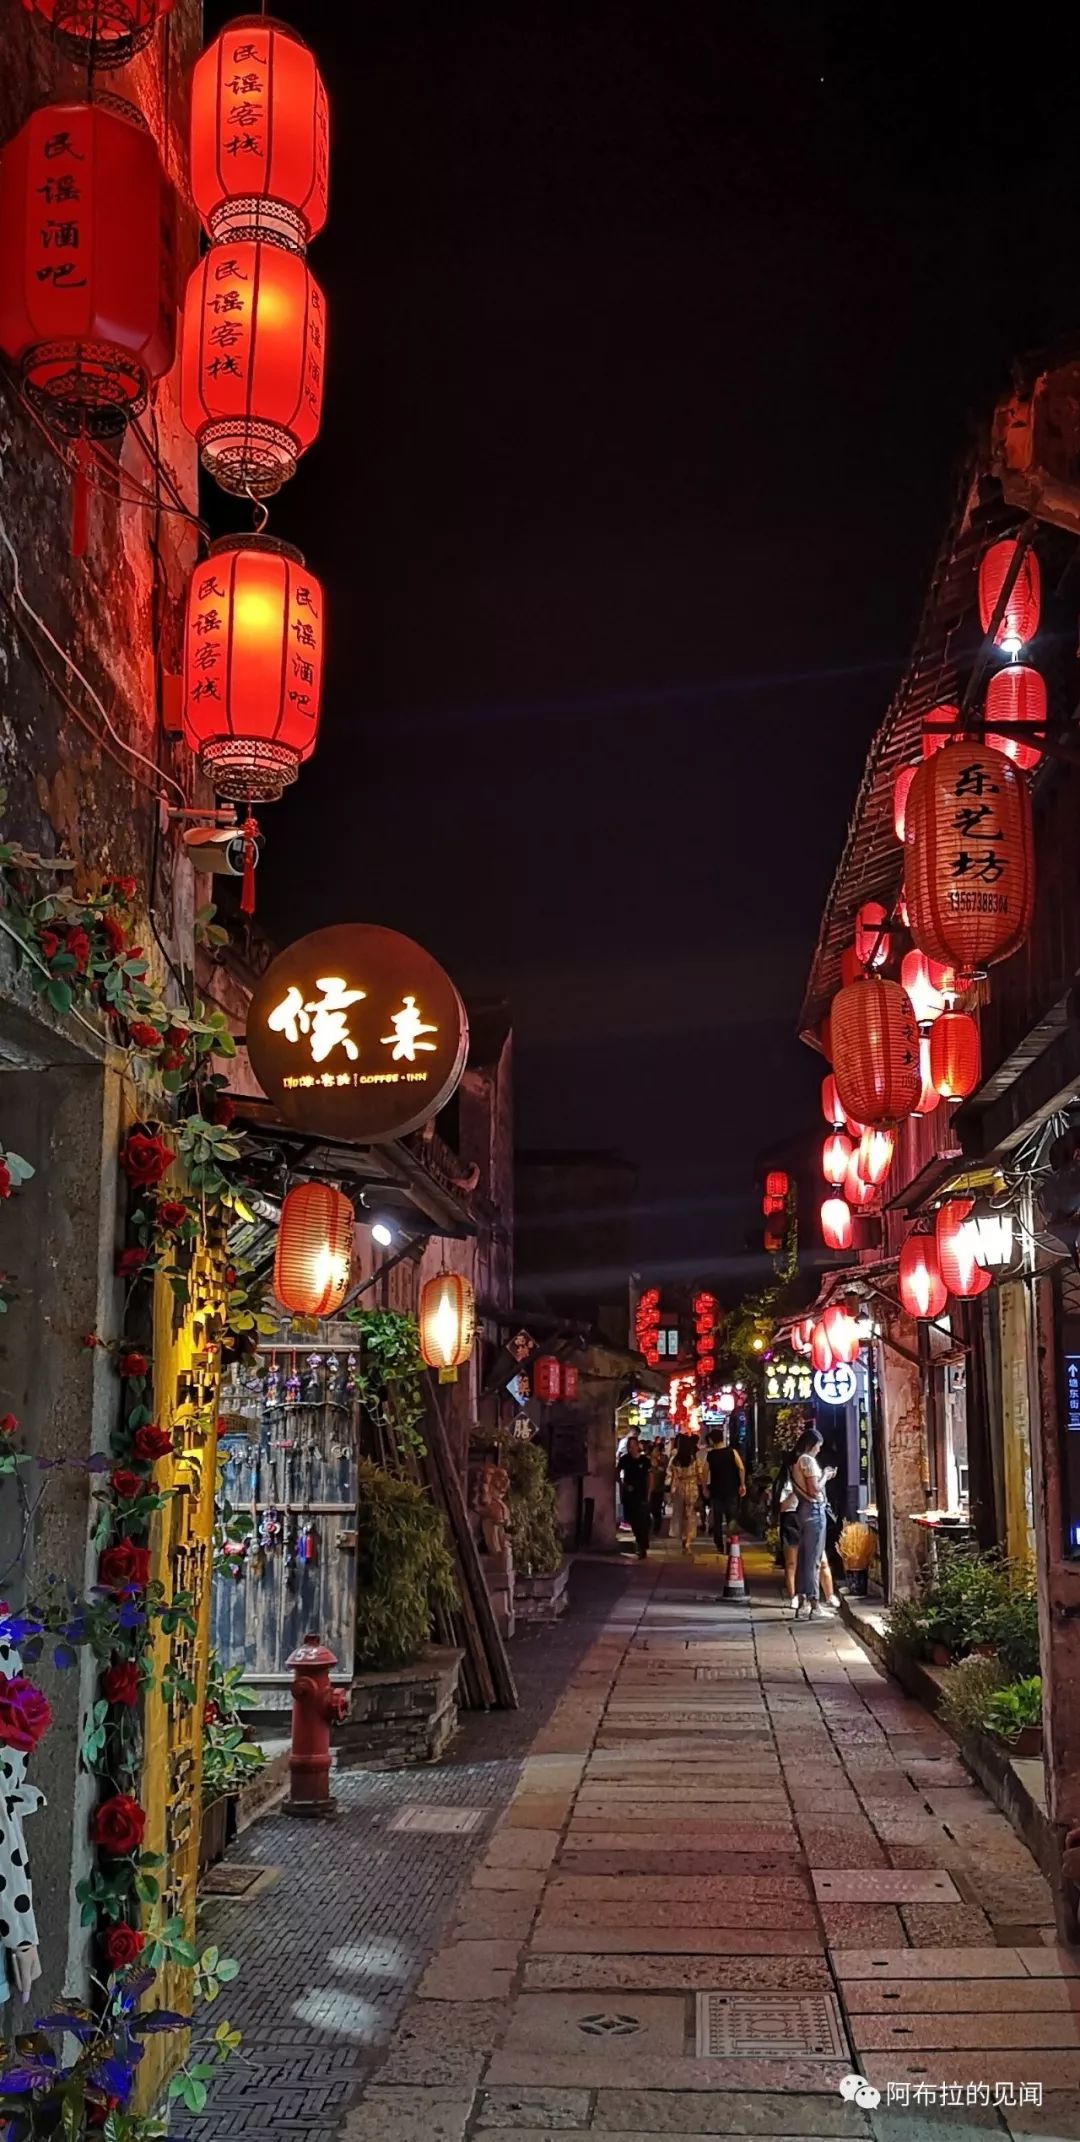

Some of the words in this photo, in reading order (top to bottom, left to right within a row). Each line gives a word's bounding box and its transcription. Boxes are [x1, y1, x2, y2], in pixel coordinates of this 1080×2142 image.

[222, 44, 267, 158] 民谣客栈
[36, 132, 87, 289] 民谣酒吧
[206, 260, 249, 379] 民谣客栈
[190, 576, 226, 702] 民谣客栈
[288, 587, 319, 720] 民谣酒吧
[950, 763, 1009, 883] 乐艺坊
